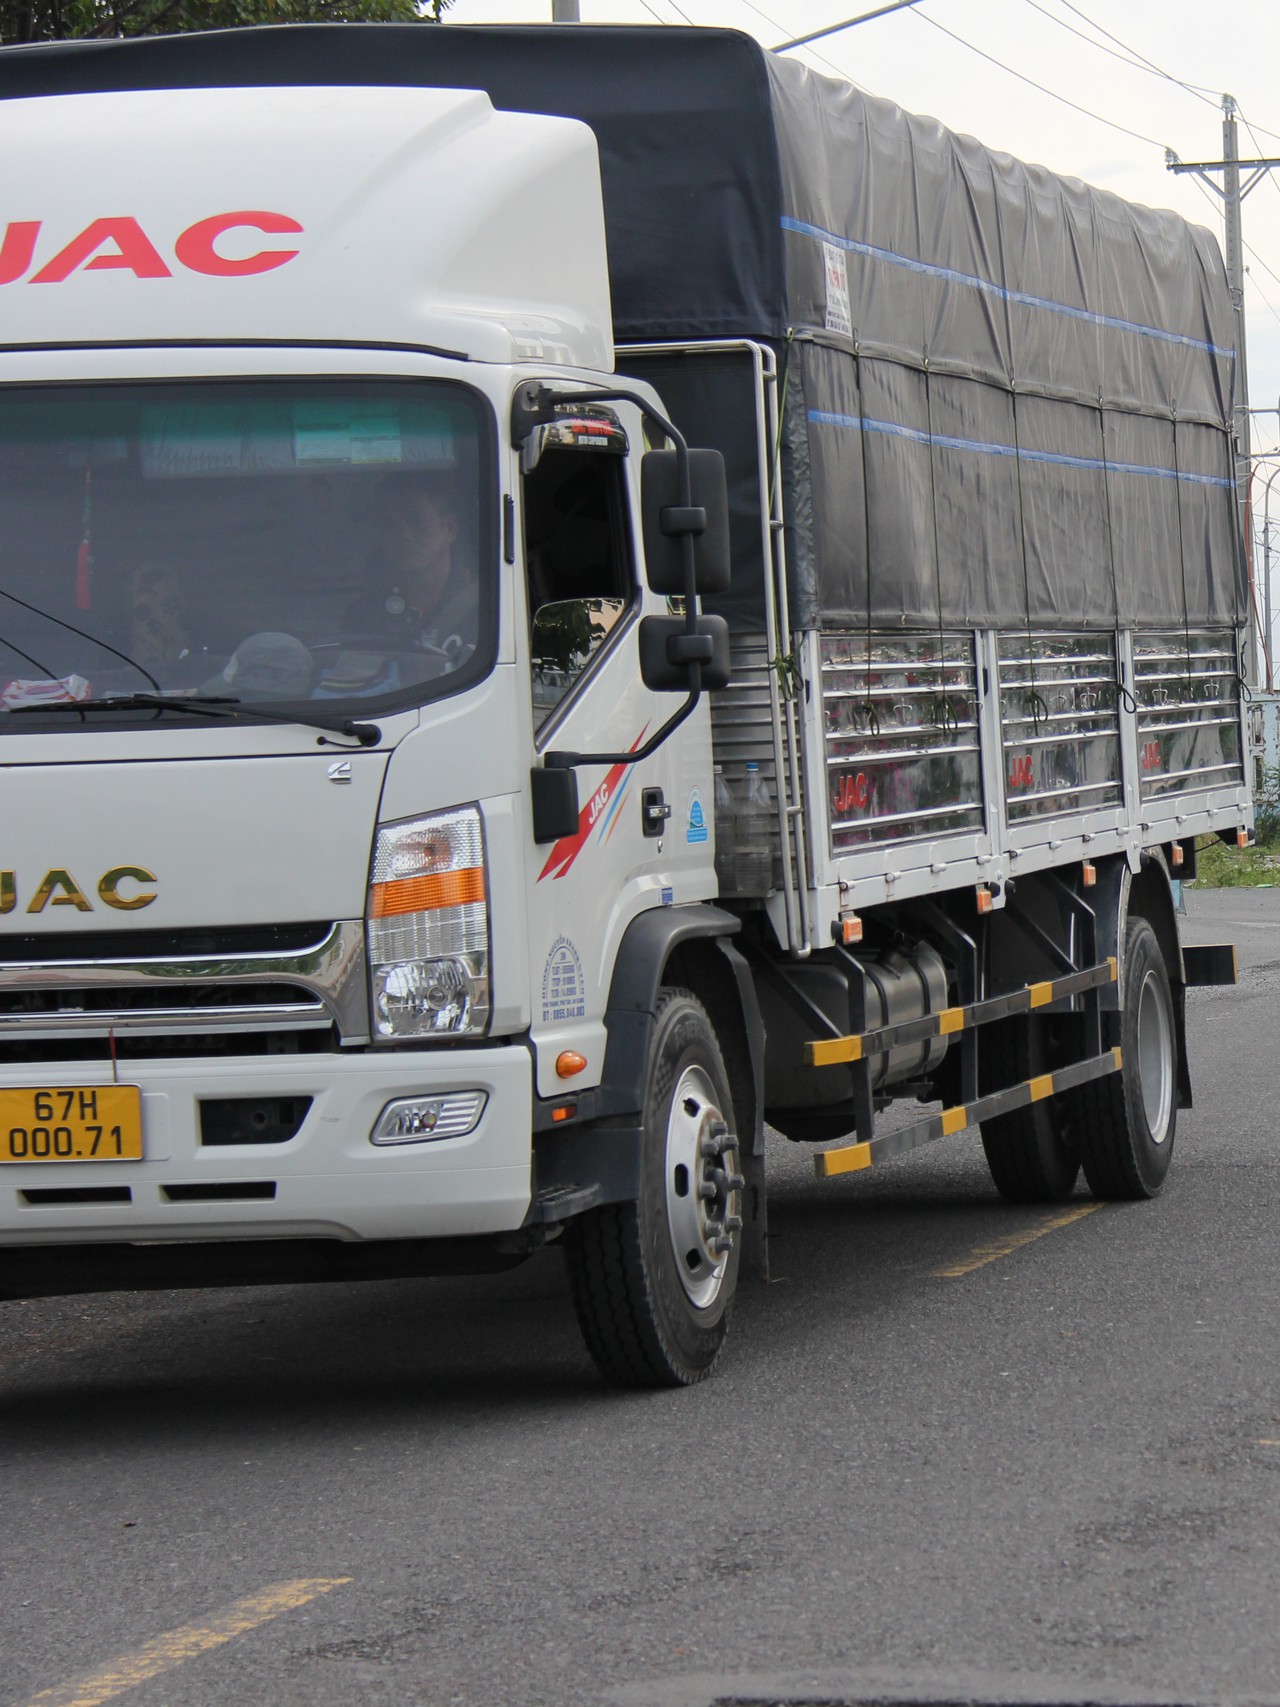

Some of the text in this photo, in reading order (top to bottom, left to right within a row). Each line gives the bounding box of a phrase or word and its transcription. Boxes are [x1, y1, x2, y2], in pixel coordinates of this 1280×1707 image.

[0, 211, 304, 285] JAC
[1009, 754, 1034, 787] JAC
[1142, 740, 1162, 769] JAC
[588, 783, 609, 825] JAC
[834, 772, 867, 812] JAC
[0, 864, 158, 914] JAC
[34, 1090, 97, 1121] 67H
[9, 1125, 122, 1157] 000.71
